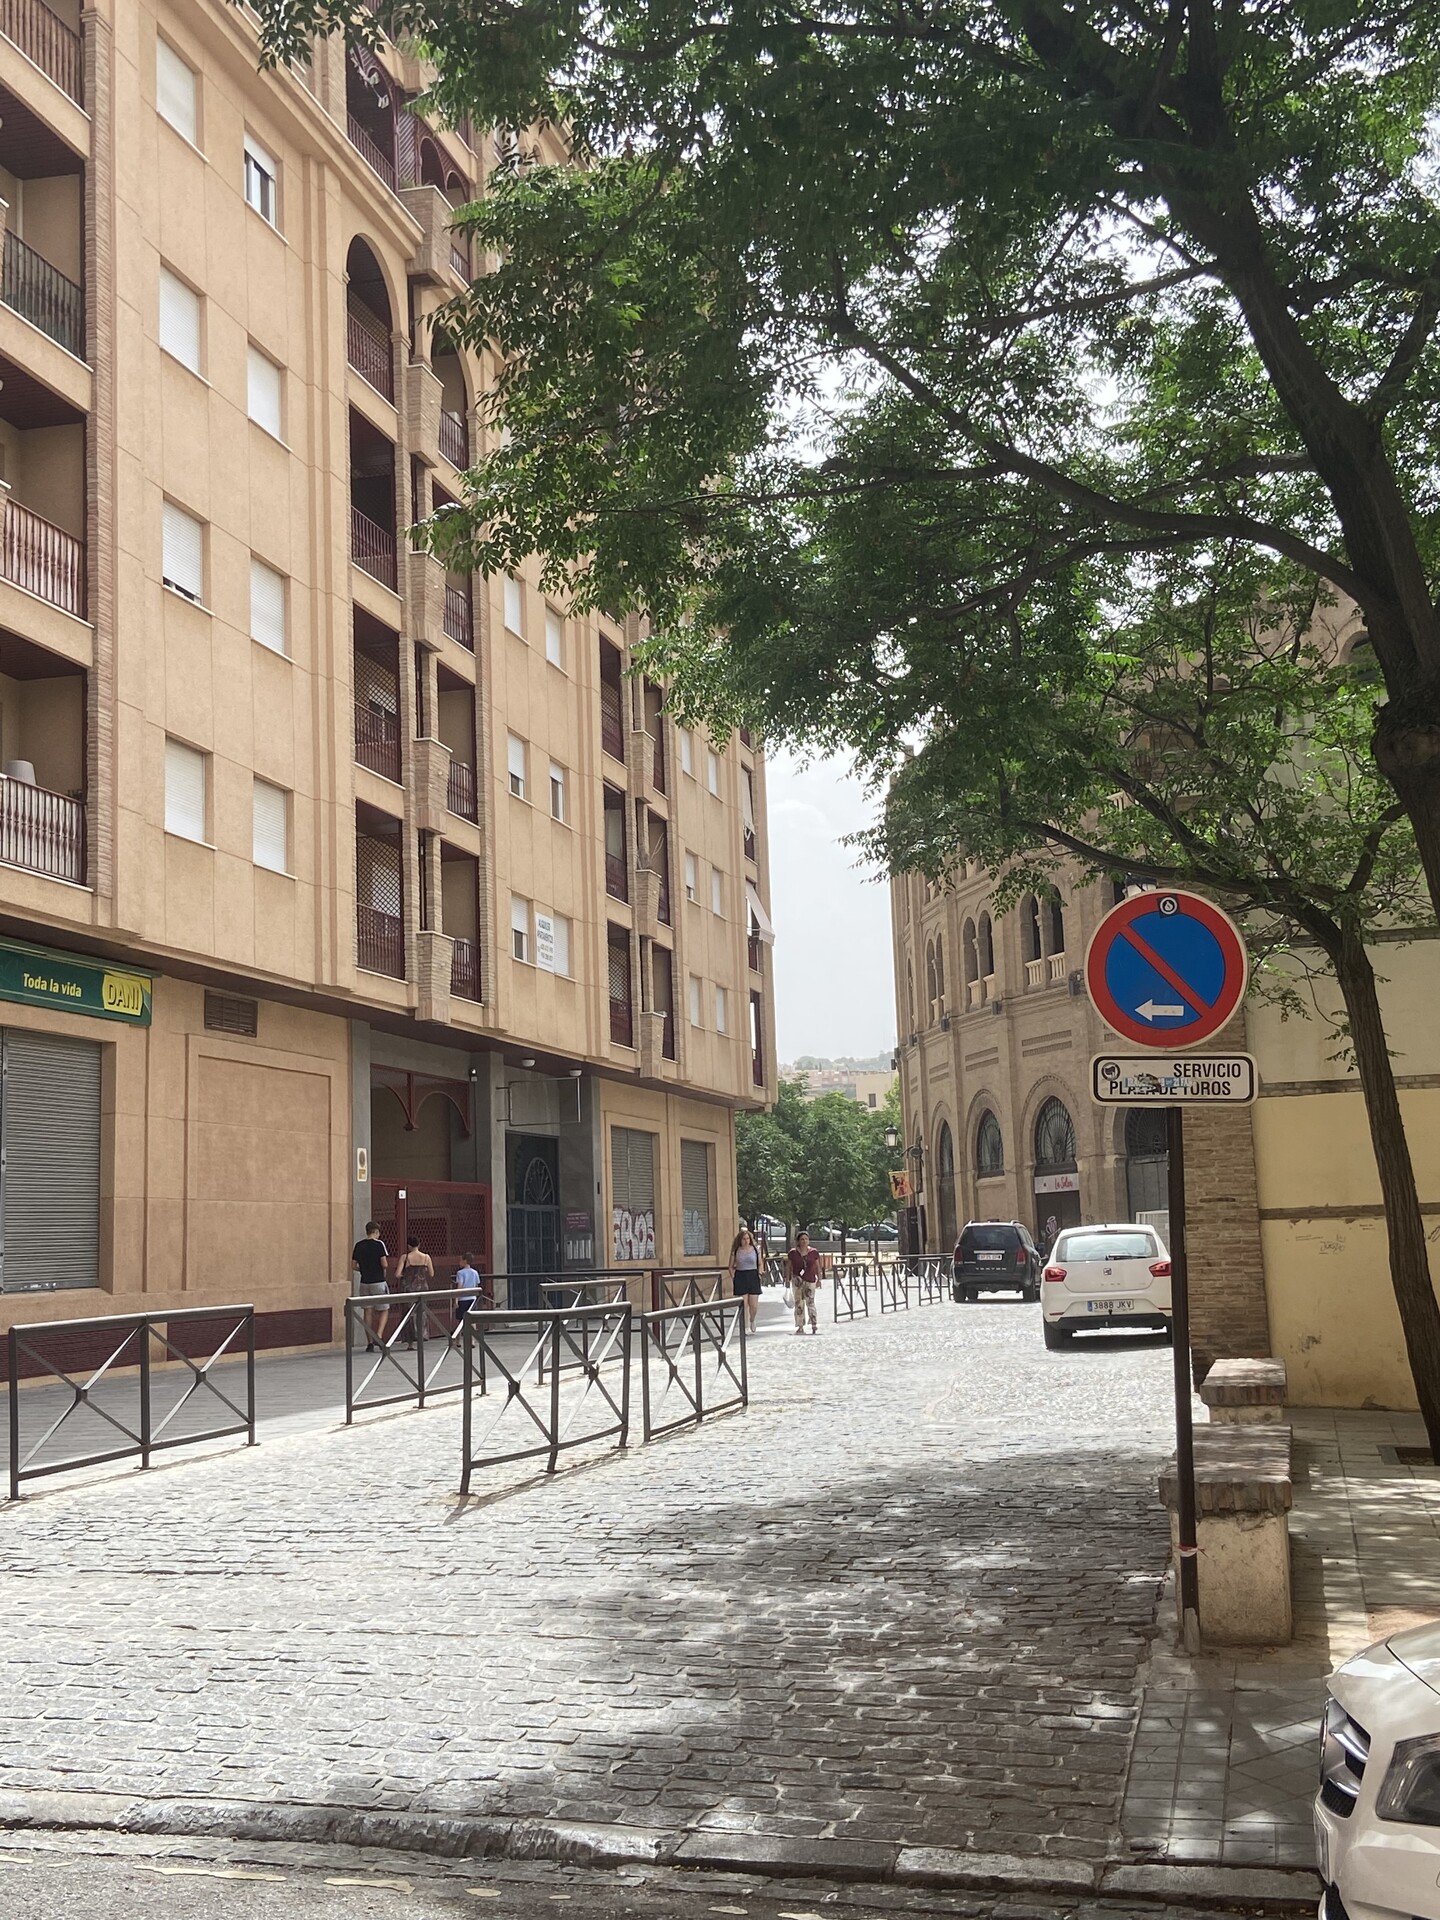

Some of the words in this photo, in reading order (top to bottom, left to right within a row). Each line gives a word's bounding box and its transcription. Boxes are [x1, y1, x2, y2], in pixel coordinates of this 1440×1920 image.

[23, 972, 47, 990] Toda
[49, 978, 59, 993] la
[61, 982, 82, 998] vida
[108, 983, 140, 1011] DANI
[1173, 1063, 1241, 1078] SERVICIO
[1093, 1301, 1114, 1310] 3888
[1116, 1300, 1132, 1309] JKV
